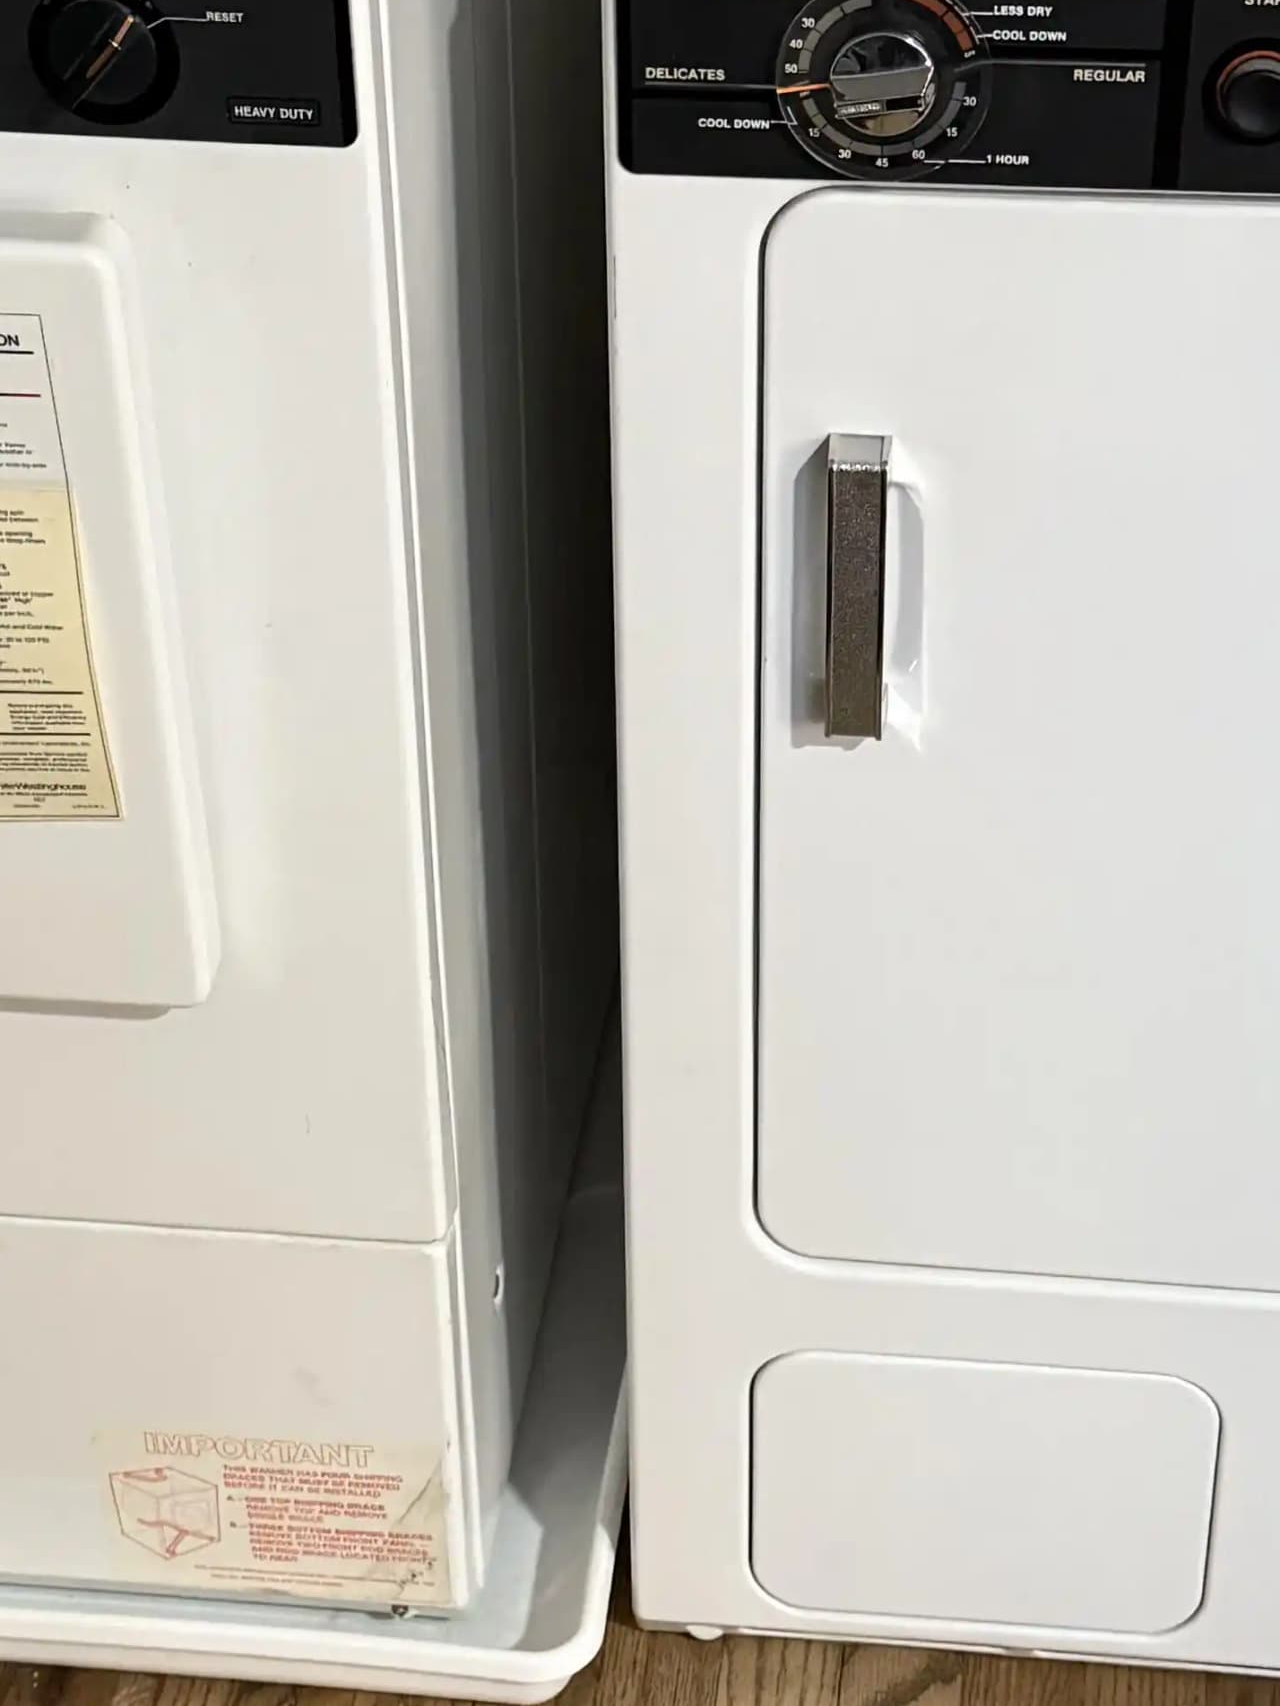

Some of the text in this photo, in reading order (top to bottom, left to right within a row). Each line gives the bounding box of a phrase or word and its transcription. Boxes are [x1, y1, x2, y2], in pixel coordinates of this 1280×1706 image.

[994, 6, 1052, 16] LESS DRY
[206, 12, 243, 23] RESET
[802, 18, 815, 28] 30
[993, 30, 1066, 41] COOL DOWN
[789, 40, 802, 48] 40
[645, 67, 725, 80] DELICATES
[785, 64, 797, 73] 50
[1074, 69, 1145, 82] REGULAR
[963, 96, 976, 106] 30
[235, 106, 313, 120] HEAVY DUTY
[698, 118, 769, 129] COOL DOWN
[808, 128, 820, 137] 15
[946, 127, 957, 136] 15
[838, 149, 851, 159] 30
[912, 151, 925, 160] 60
[876, 158, 888, 167] 45
[987, 155, 1029, 165] 1 HOUR
[144, 1431, 374, 1469] IMPORTANT
